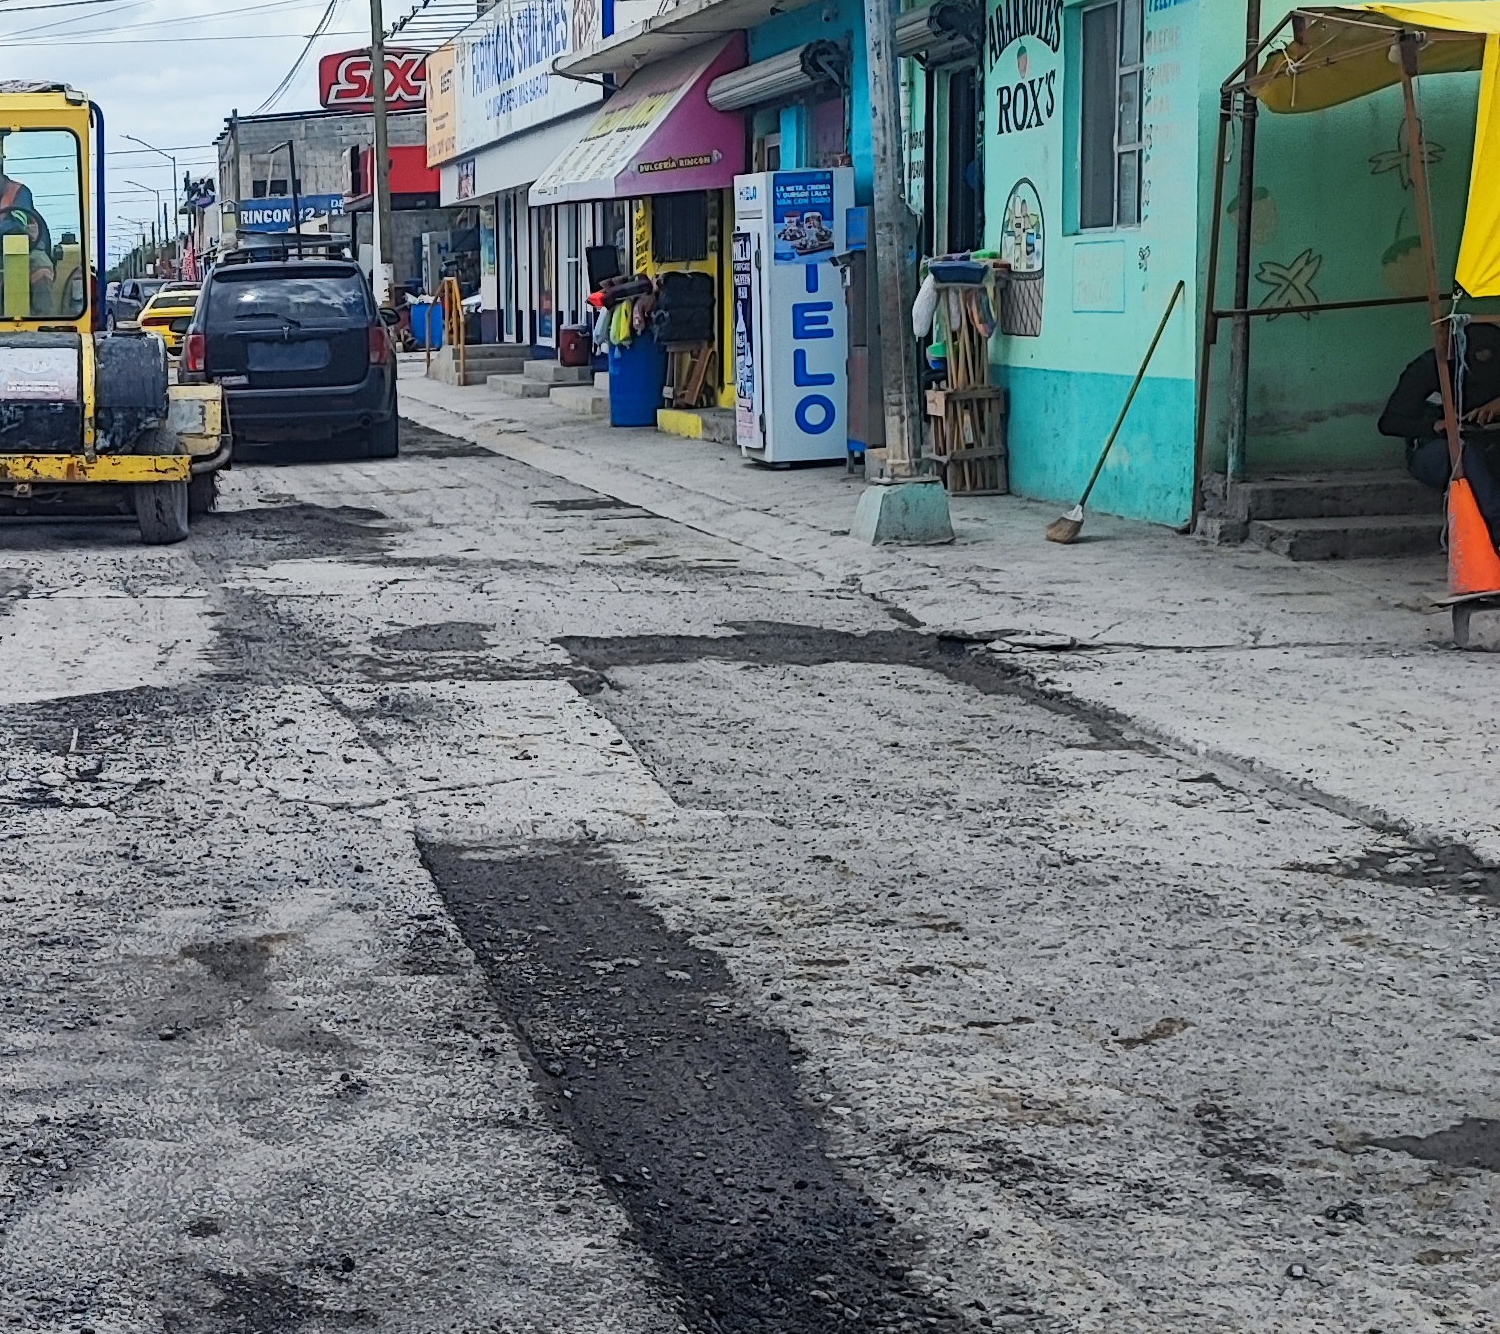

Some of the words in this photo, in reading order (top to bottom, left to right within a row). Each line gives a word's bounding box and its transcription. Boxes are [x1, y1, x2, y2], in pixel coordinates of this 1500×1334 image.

[471, 13, 515, 98] FARMACIAS
[997, 69, 1056, 135] ROX'S
[240, 209, 291, 225] RINCON
[793, 263, 835, 435] IELO
